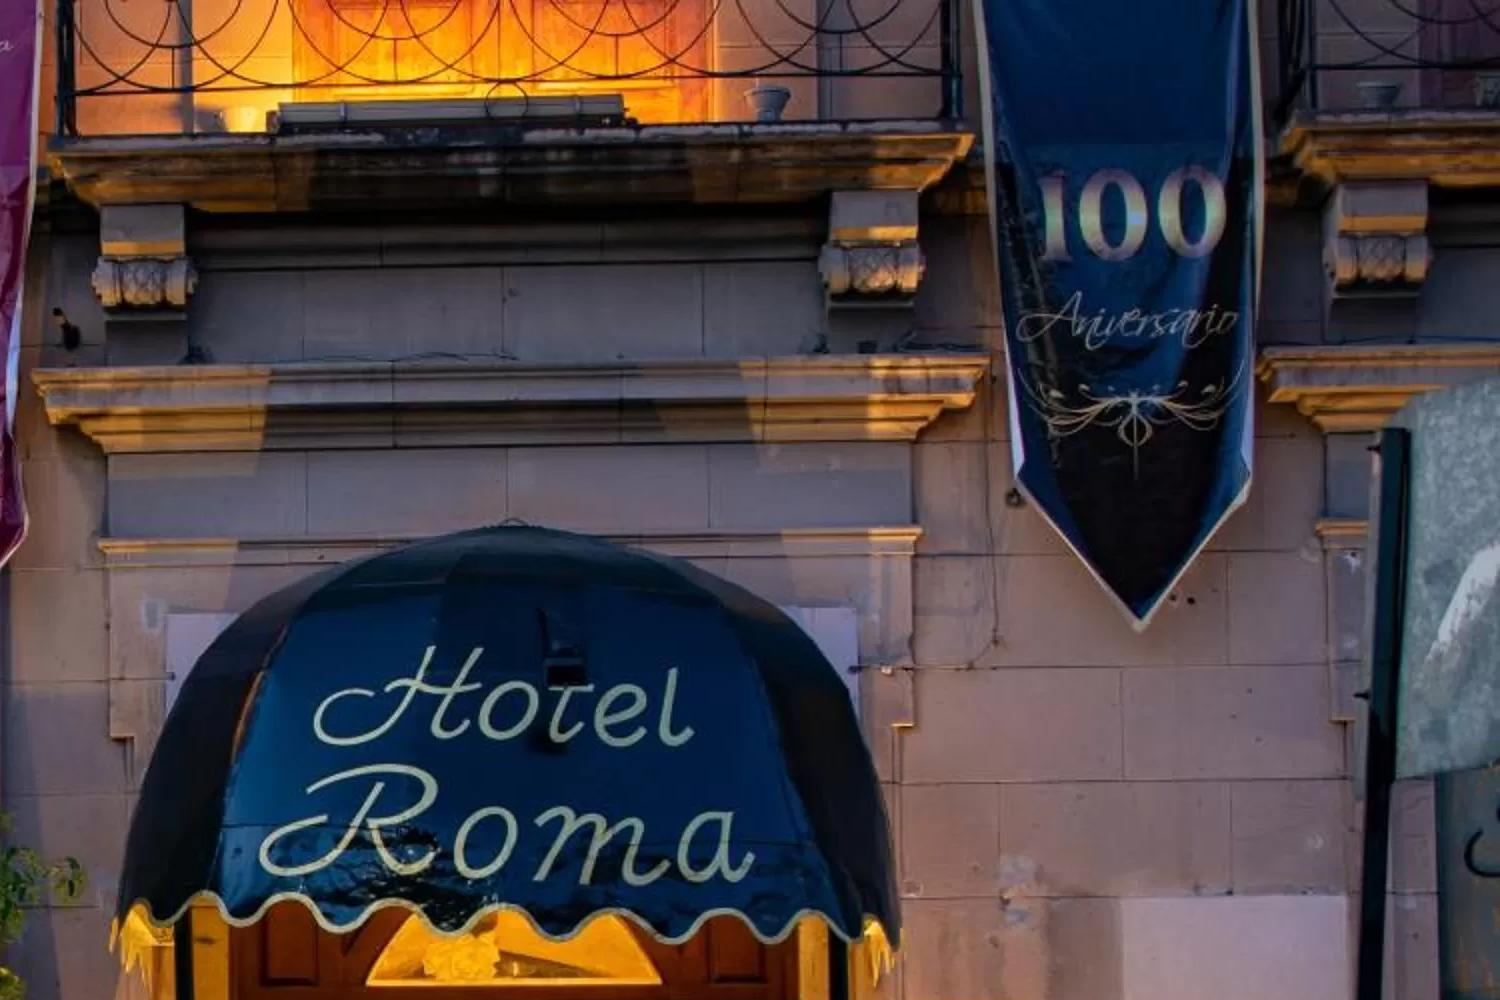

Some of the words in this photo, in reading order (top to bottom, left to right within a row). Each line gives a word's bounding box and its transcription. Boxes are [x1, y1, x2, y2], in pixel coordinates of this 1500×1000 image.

[1037, 165, 1228, 263] 100
[1016, 289, 1239, 352] Aniversario
[311, 644, 697, 749] Hotel
[257, 762, 757, 888] Roma
